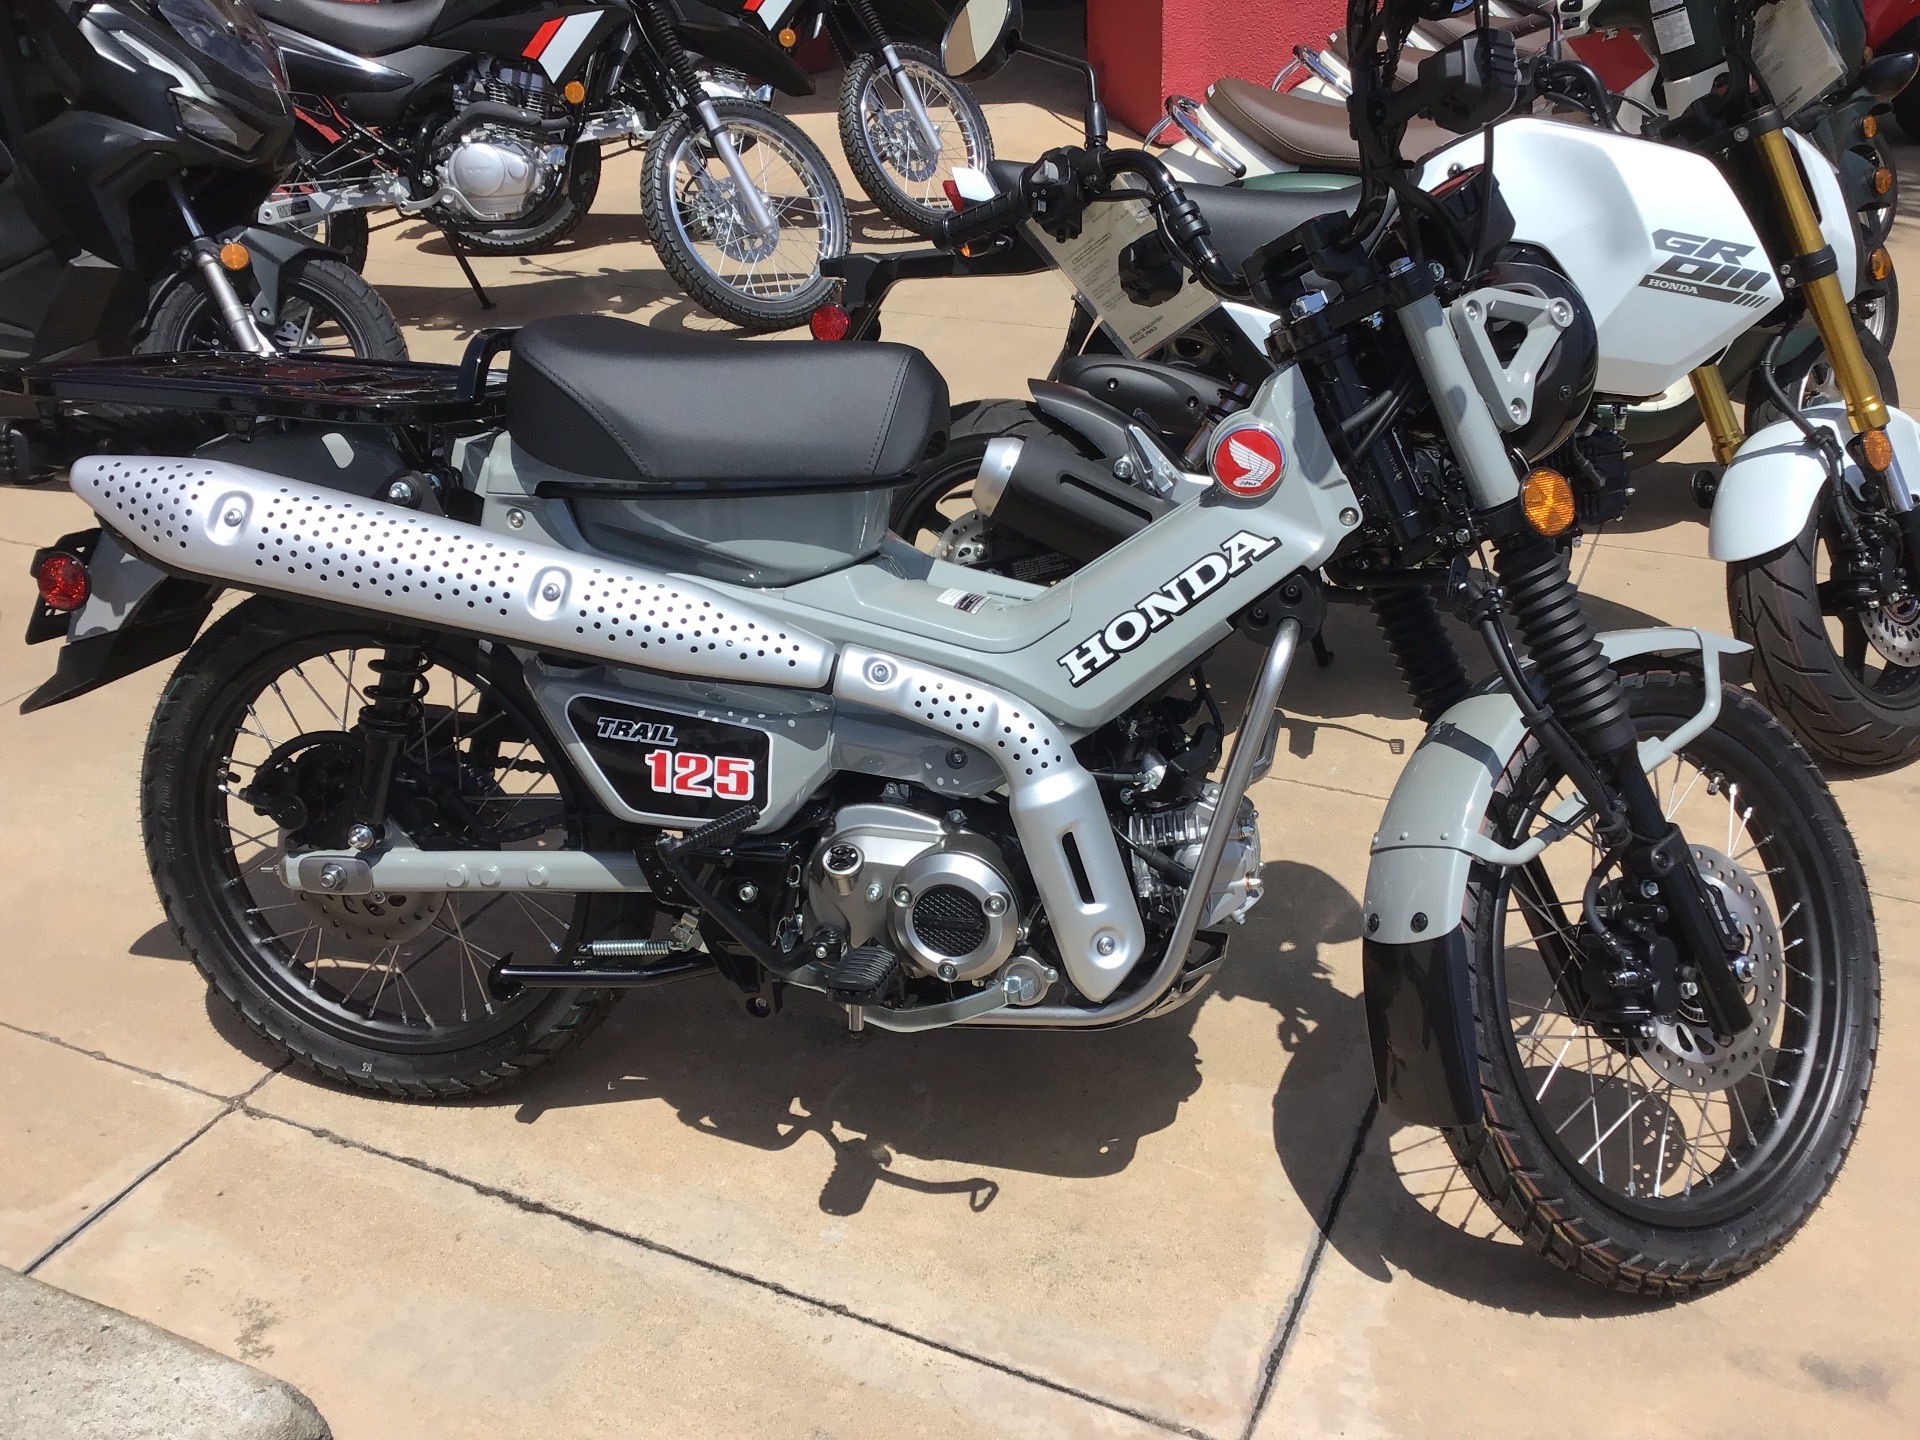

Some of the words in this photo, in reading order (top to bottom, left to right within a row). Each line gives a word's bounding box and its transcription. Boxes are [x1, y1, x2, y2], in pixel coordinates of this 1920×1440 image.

[1651, 228, 1756, 266] GR
[1647, 278, 1699, 294] HONDA
[1057, 529, 1283, 688] HONDA
[597, 716, 678, 747] TRAIL
[644, 749, 755, 801] 125
